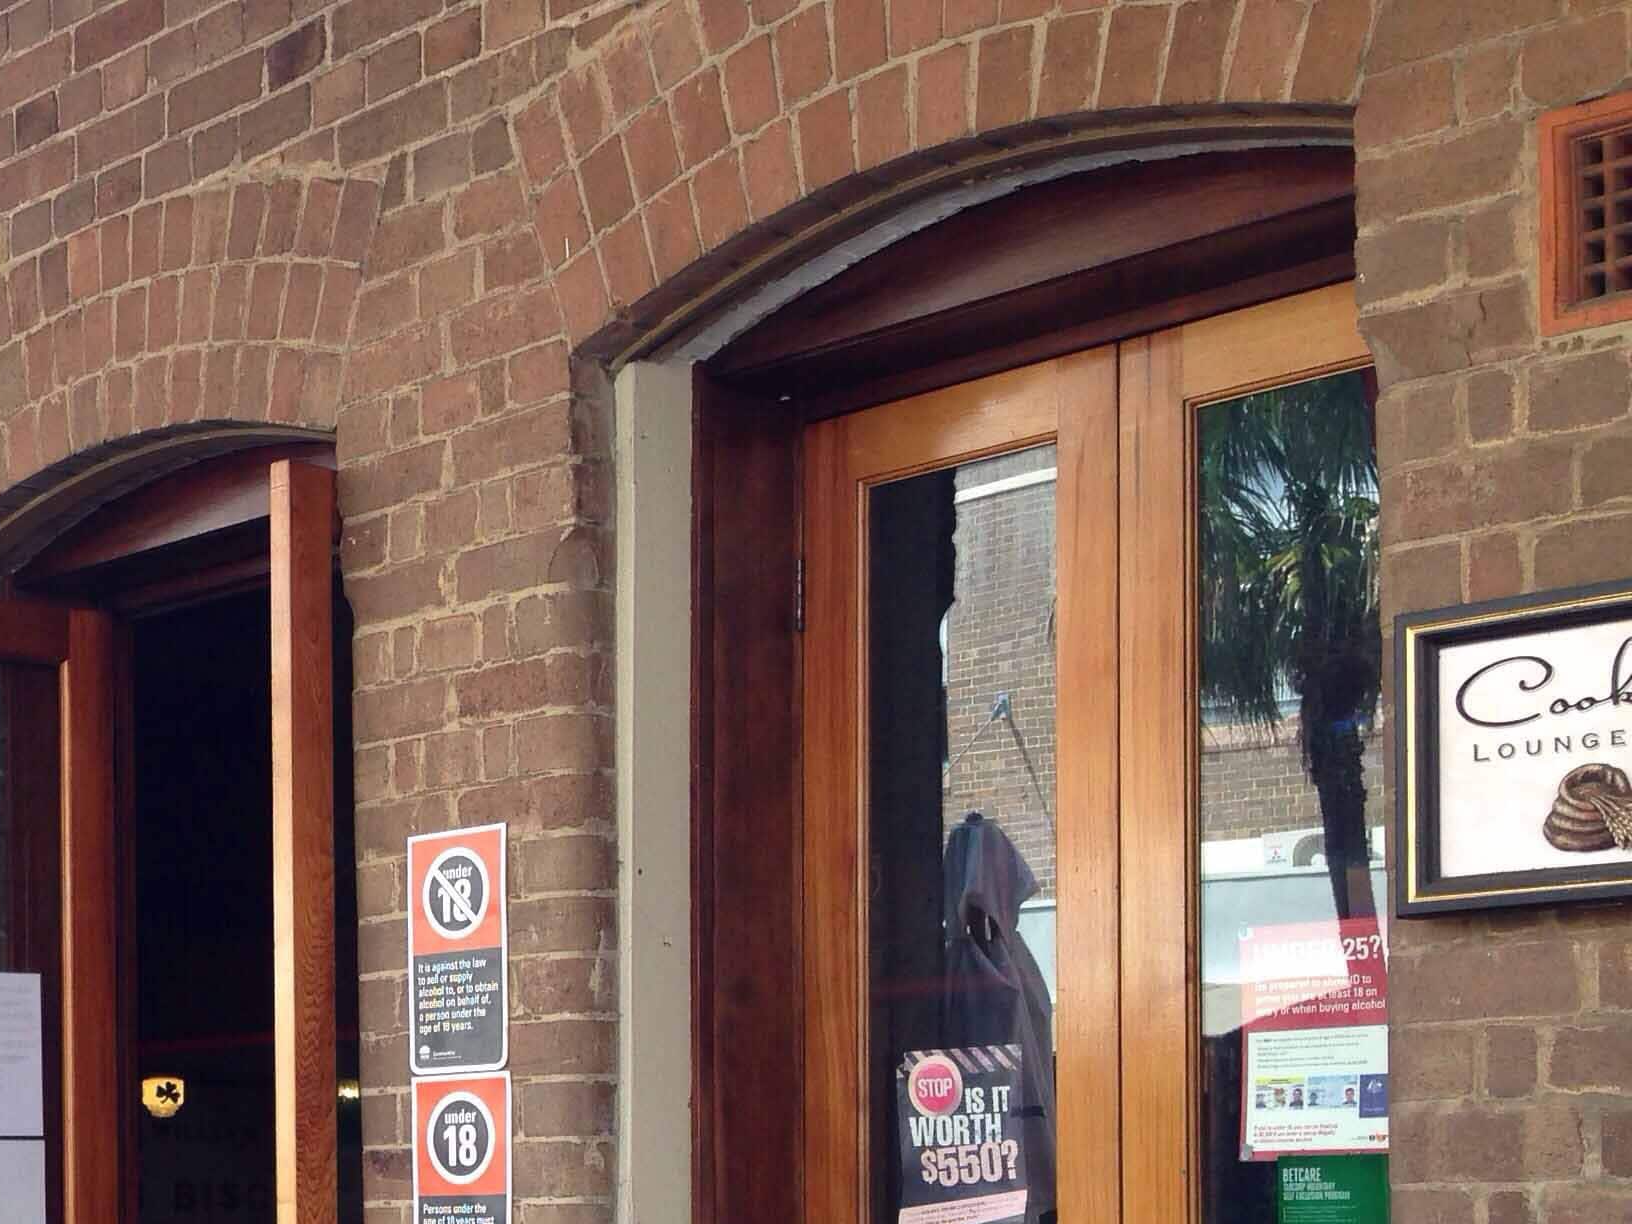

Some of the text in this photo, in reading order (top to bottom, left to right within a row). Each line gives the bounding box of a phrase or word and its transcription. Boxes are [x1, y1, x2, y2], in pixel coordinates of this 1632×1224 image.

[1473, 729, 1627, 763] LOUNGE
[1343, 934, 1381, 961] 25?
[432, 962, 458, 974] against
[459, 959, 471, 970] the
[472, 957, 487, 969] law
[440, 975, 448, 984] or
[1362, 974, 1372, 985] to
[418, 986, 444, 998] alcohol
[457, 986, 465, 994] or
[466, 984, 474, 994] to
[475, 980, 499, 993] obtain
[1353, 986, 1364, 998] 18
[1366, 987, 1377, 997] on
[418, 998, 445, 1010] alcohol
[1292, 1004, 1317, 1015] when
[1319, 1002, 1350, 1014] buying
[1351, 999, 1386, 1011] alcohol
[451, 1008, 473, 1019] under
[473, 1007, 486, 1017] the
[918, 1078, 953, 1099] STOP
[965, 1085, 1011, 1114] IS IT
[444, 1108, 477, 1125] under
[909, 1112, 1003, 1148] WORTH
[443, 1124, 478, 1167] 18
[920, 1139, 1019, 1188] $550?
[1282, 1167, 1321, 1182] BETCARE
[423, 1203, 487, 1215] Persons under the
